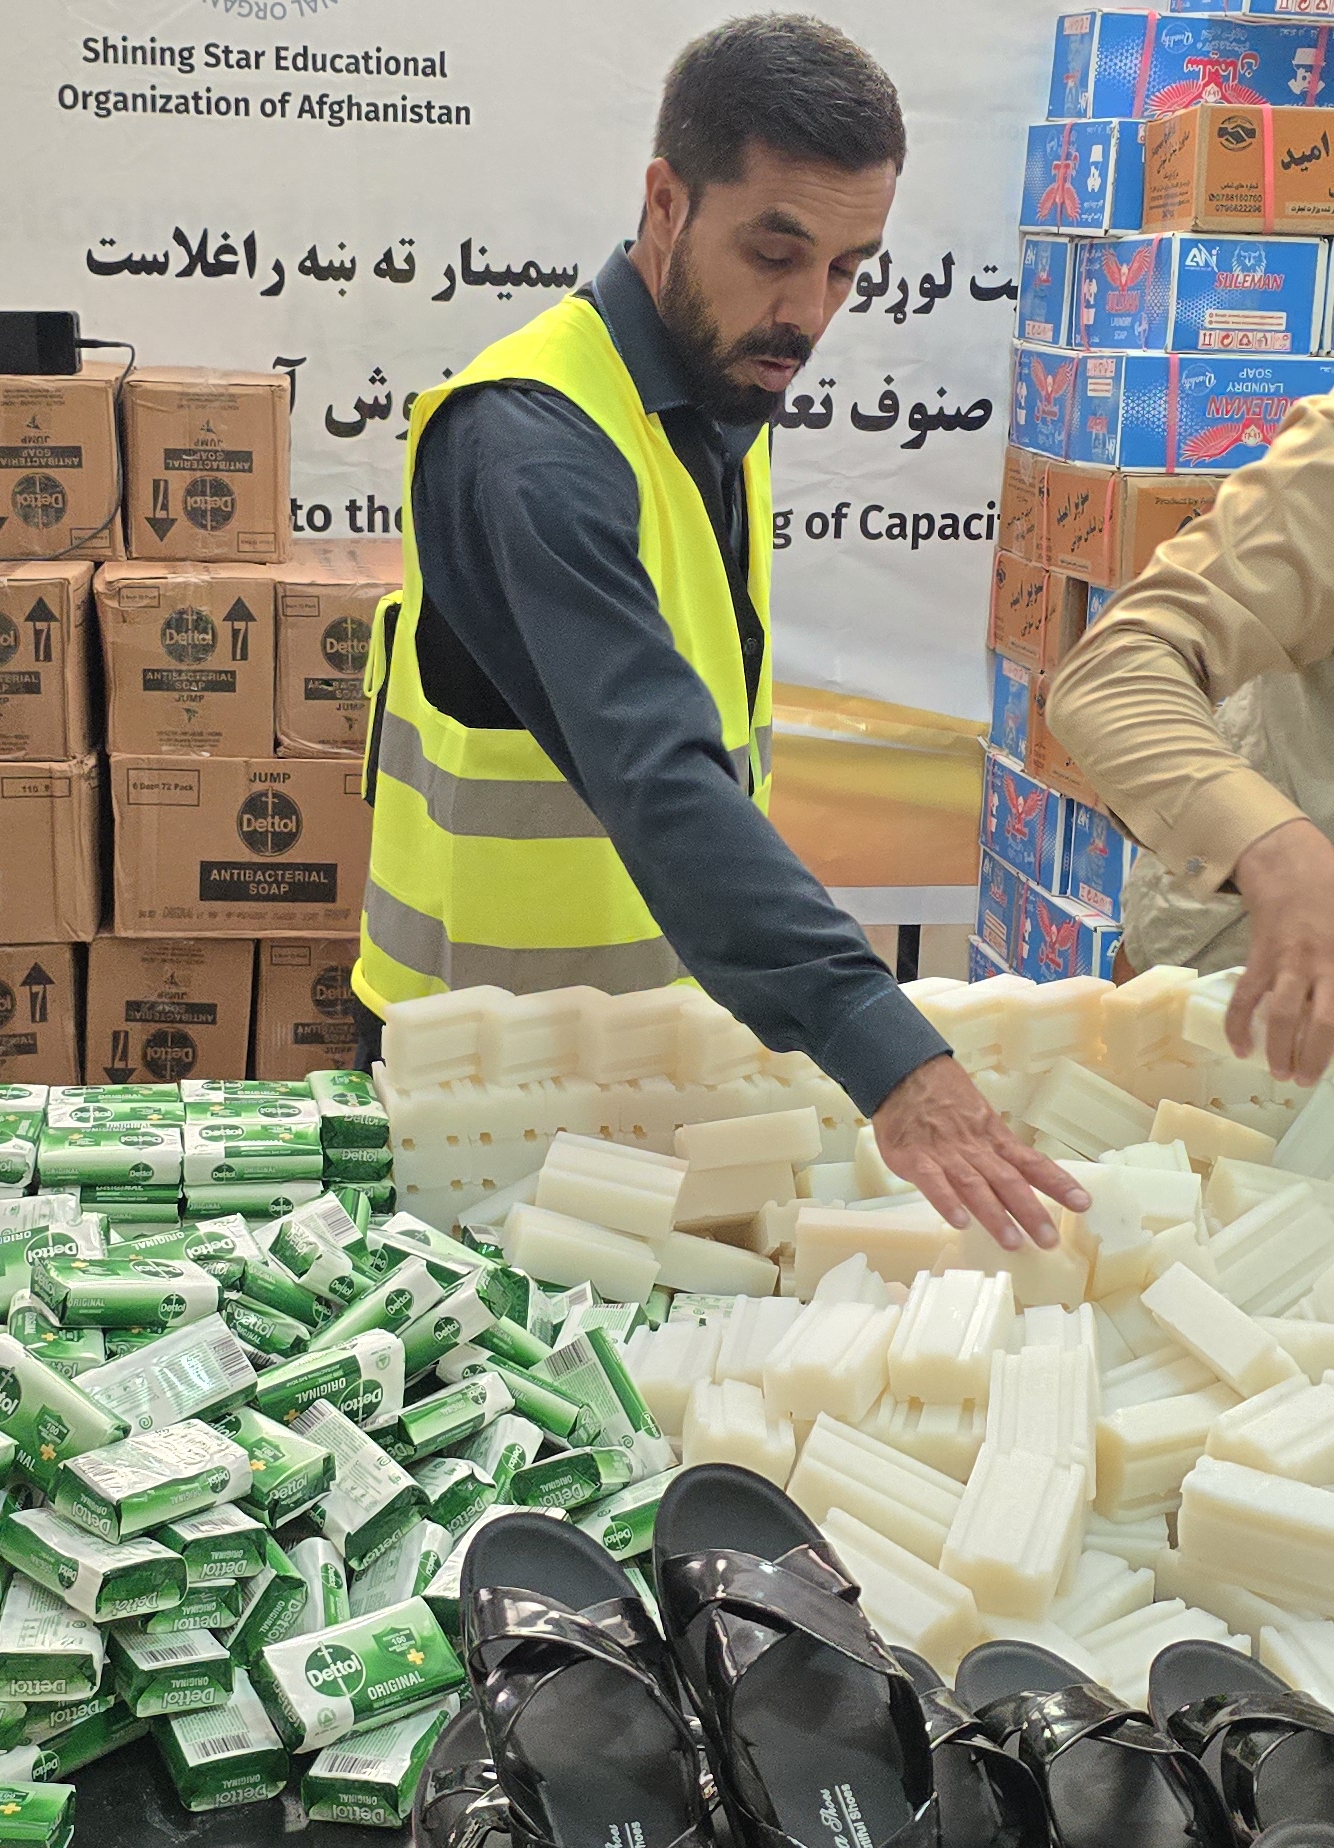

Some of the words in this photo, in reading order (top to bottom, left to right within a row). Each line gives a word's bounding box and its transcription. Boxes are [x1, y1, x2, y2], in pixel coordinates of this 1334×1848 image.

[82, 36, 195, 73] Shining
[204, 42, 265, 71] Star
[275, 45, 447, 79] Educational
[58, 84, 250, 118] Organization
[260, 92, 292, 119] of
[298, 95, 471, 127] Afghanistan
[373, 238, 415, 283] ته
[1216, 272, 1284, 291] SULEMAN
[1239, 368, 1272, 379] SOAP
[1226, 381, 1284, 393] LAUNDRY
[850, 374, 993, 449] صنوف
[18, 494, 63, 507] Dettol
[186, 497, 232, 511] Dettol
[290, 498, 332, 532] to
[805, 502, 851, 540] of
[860, 501, 1000, 550] Capaci
[165, 629, 213, 645] Dettol
[145, 671, 234, 682] ANTIBACTERIAL
[174, 694, 205, 703] JUMP
[174, 783, 194, 792] Pack
[250, 772, 291, 784] JUMP
[242, 814, 297, 833] Dettol
[210, 869, 328, 883] ANTIBACTERIAL
[249, 884, 289, 895] SOAP
[146, 1047, 193, 1062] Dettol
[199, 1125, 245, 1140] Dettol
[341, 1148, 379, 1163] Dettol
[25, 1243, 79, 1265] Dettol
[185, 1239, 236, 1259] Dettol
[160, 1302, 186, 1313] Dettol
[384, 1293, 413, 1315] Dettol
[433, 1320, 461, 1341] Dettol
[295, 1377, 347, 1403] ORIGINAL
[390, 1634, 407, 1645] 100
[307, 1654, 363, 1687] Dettol
[367, 1672, 425, 1701] ORIGINAL
[162, 1687, 216, 1707] Dettol
[330, 1805, 385, 1824] Dettol
